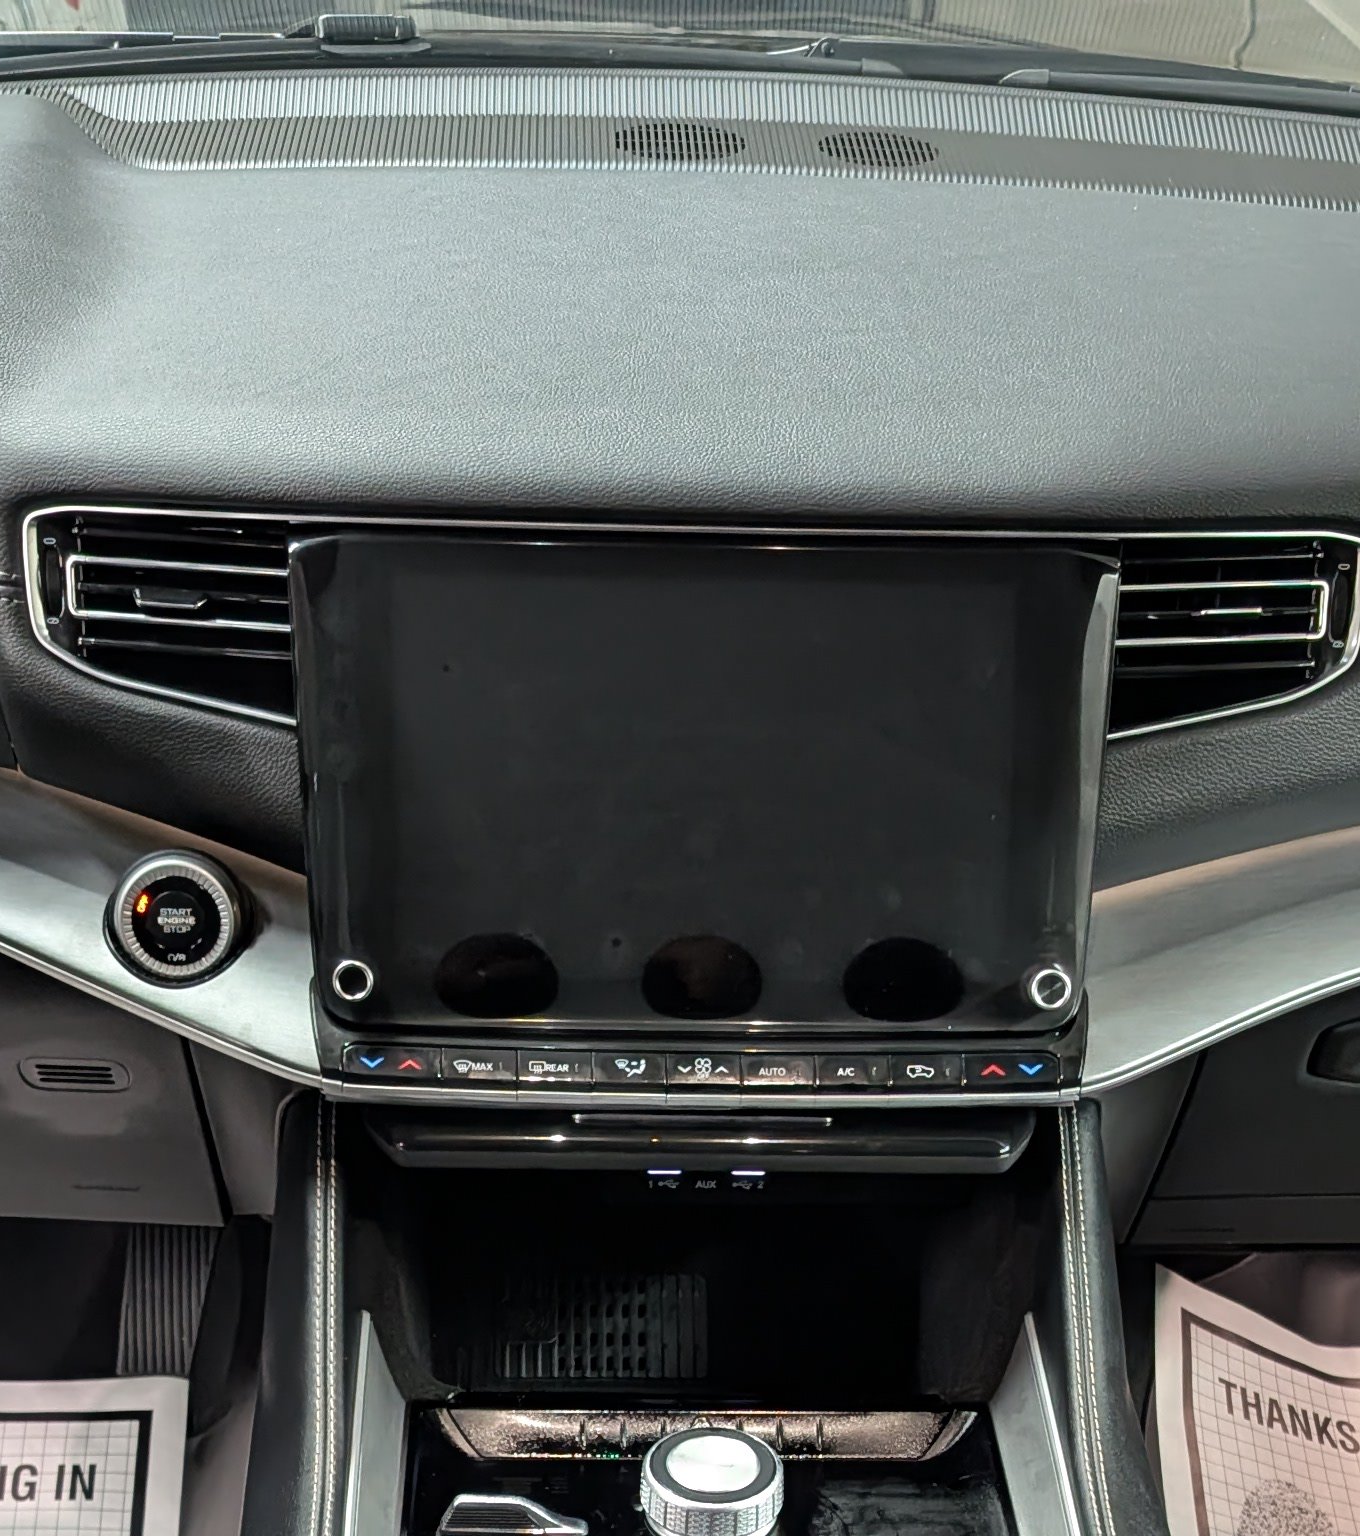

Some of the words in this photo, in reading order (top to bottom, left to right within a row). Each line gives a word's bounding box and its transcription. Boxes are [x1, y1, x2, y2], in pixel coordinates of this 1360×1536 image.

[160, 907, 192, 916] START
[157, 916, 196, 926] ENGINE
[163, 925, 191, 934] STOP
[471, 1062, 493, 1072] MAX
[545, 1063, 569, 1073] REAR
[758, 1066, 786, 1077] AUTO
[837, 1066, 855, 1077] A/C
[695, 1180, 716, 1189] AUX
[757, 1180, 764, 1189] 2
[1218, 1377, 1360, 1455] THANKS
[54, 1463, 97, 1501] IN
